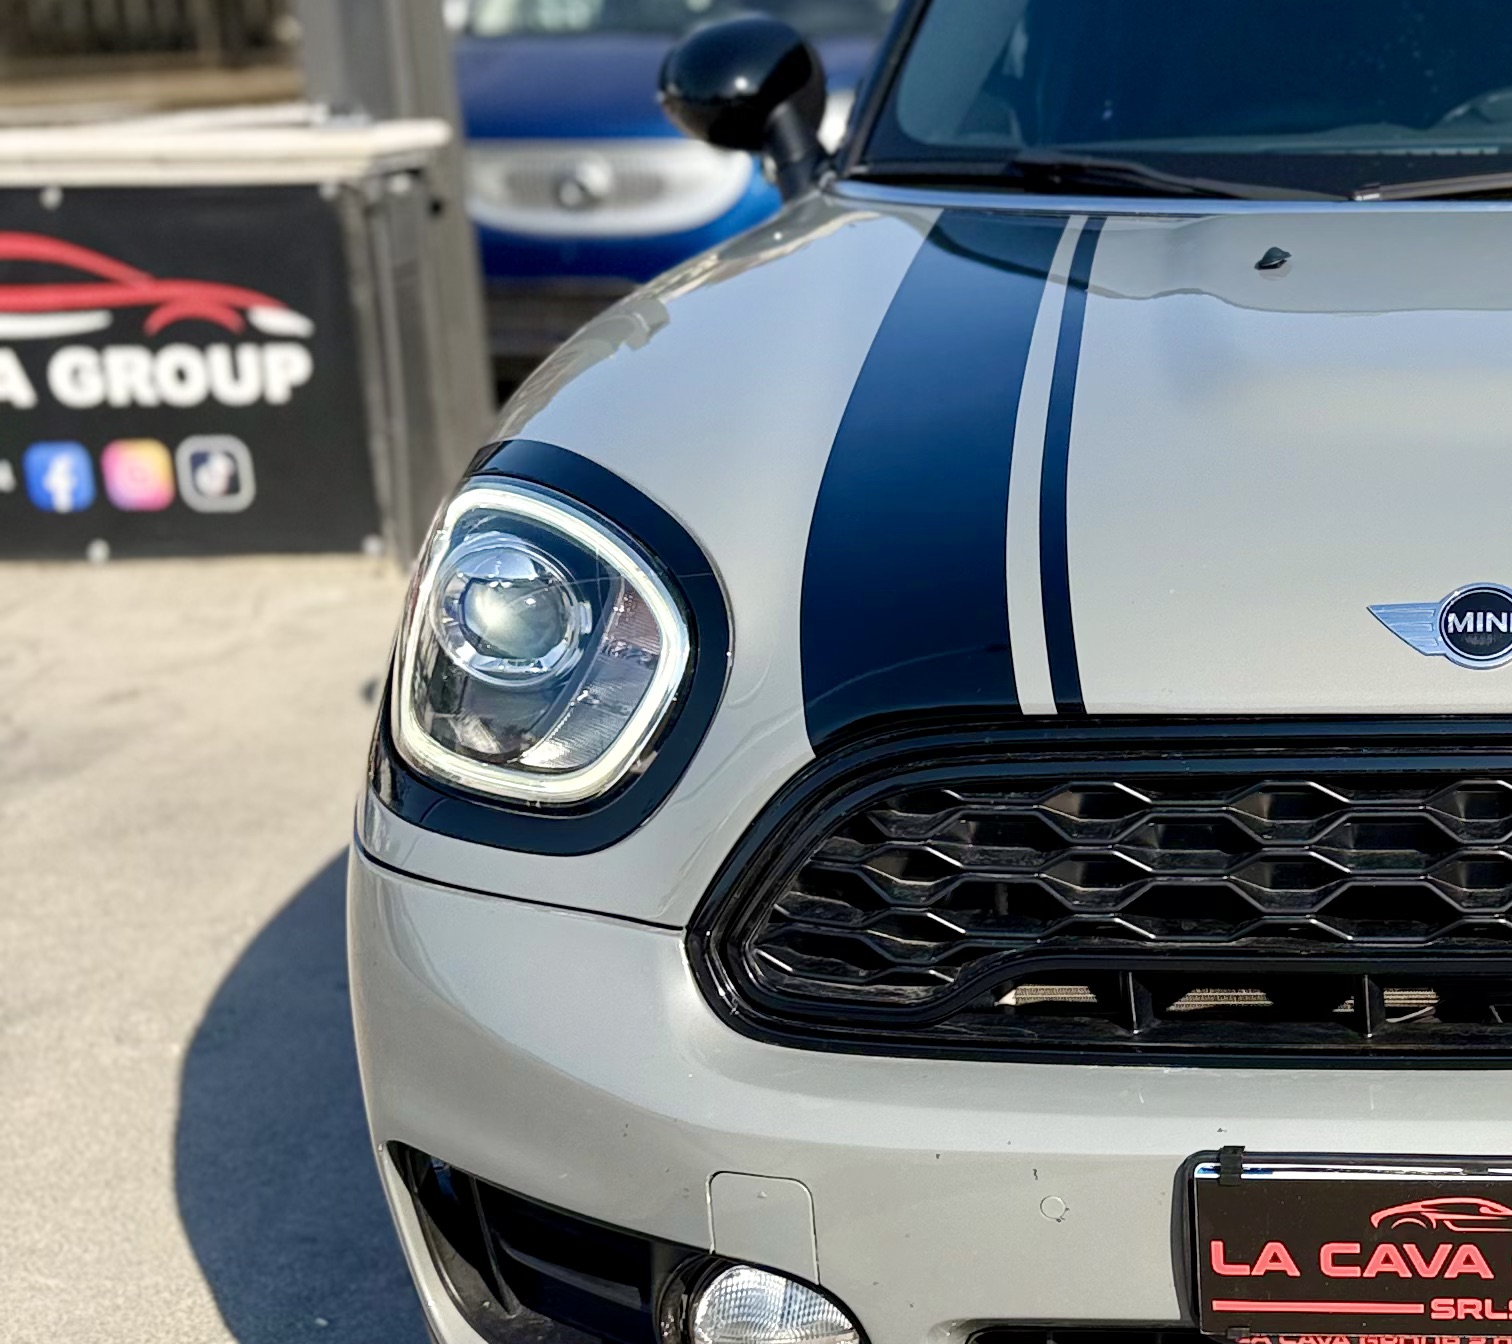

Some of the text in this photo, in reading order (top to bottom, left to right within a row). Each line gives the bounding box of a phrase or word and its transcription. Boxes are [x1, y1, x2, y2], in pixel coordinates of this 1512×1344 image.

[46, 342, 314, 409] GROUP
[1209, 1240, 1302, 1278] LA
[1318, 1241, 1496, 1280] CAVA
